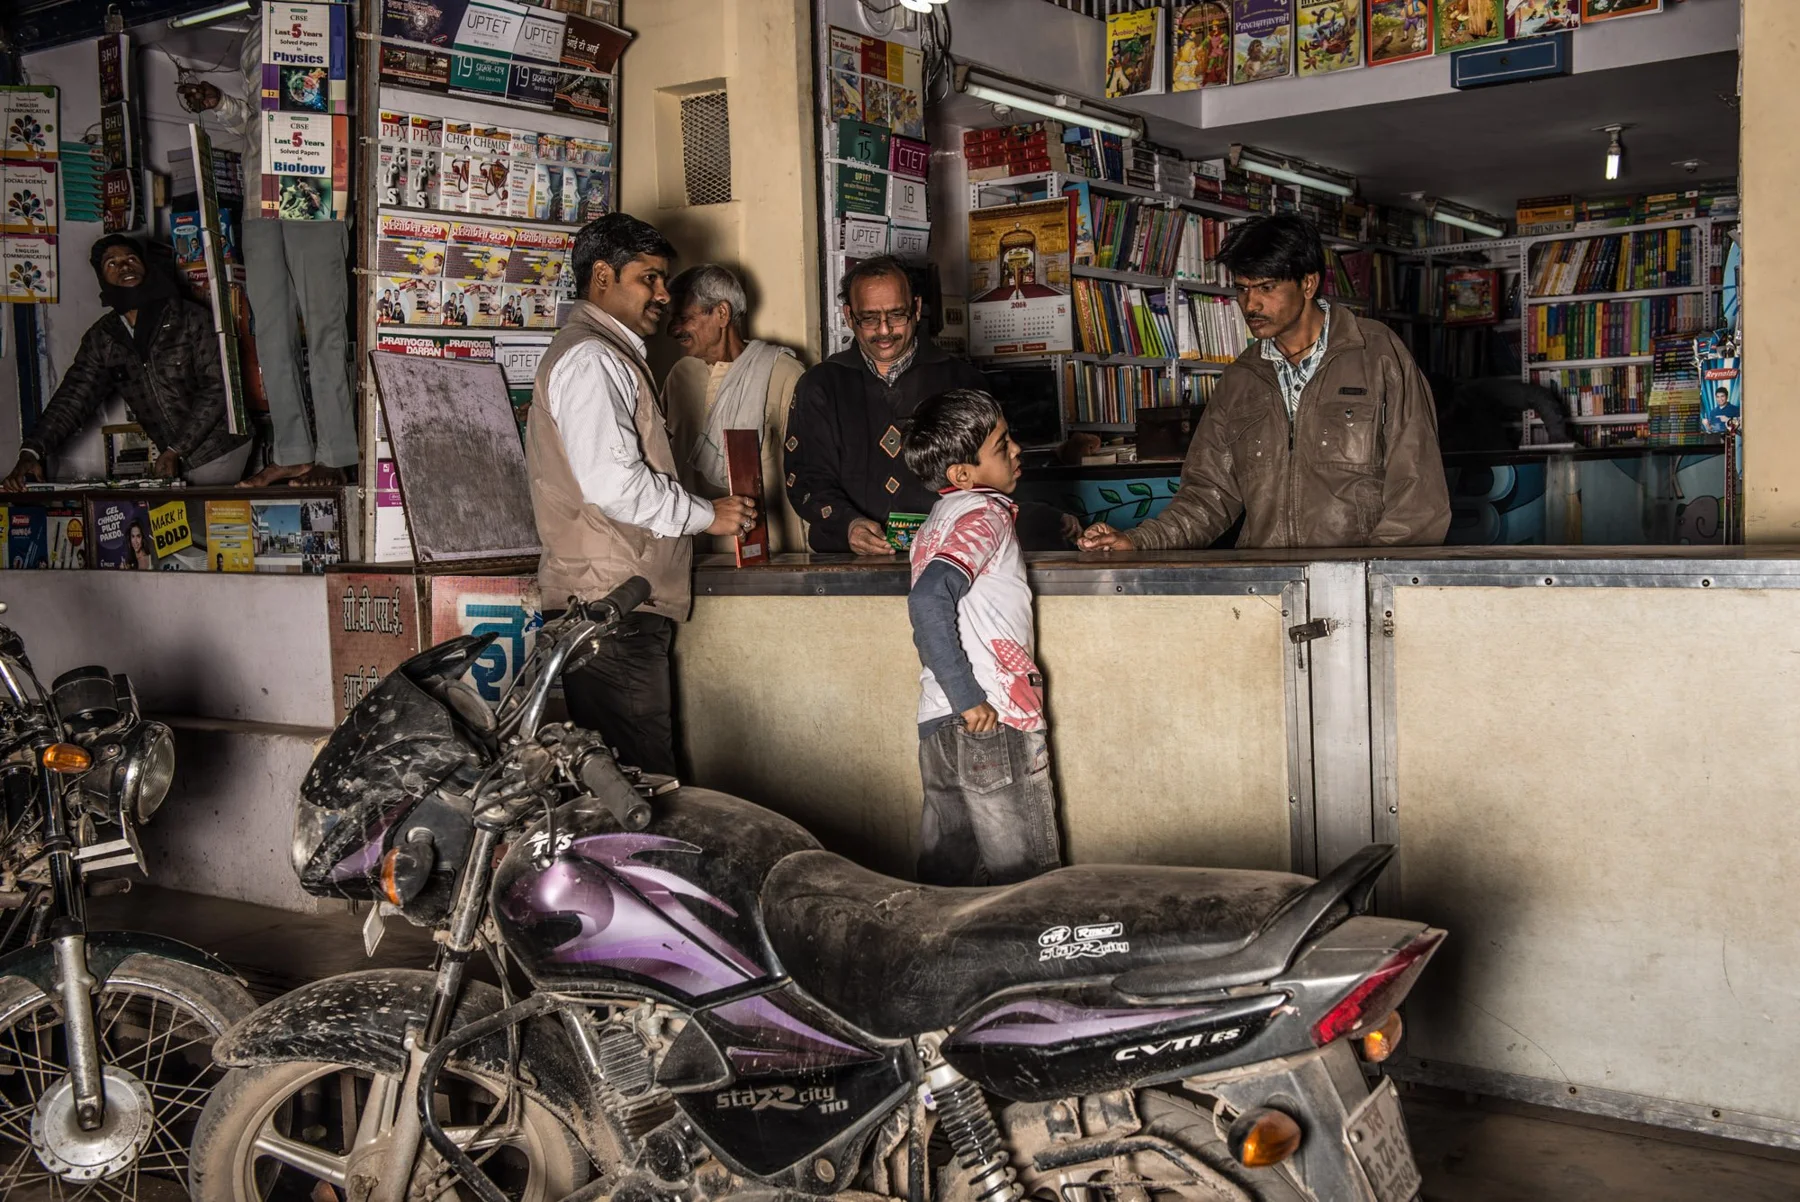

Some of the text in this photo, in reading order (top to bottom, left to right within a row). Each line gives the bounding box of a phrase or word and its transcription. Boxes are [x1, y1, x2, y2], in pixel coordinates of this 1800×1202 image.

[291, 23, 302, 38] 5
[467, 13, 511, 35] UPTET
[524, 25, 560, 46] UPTET
[273, 52, 324, 64] Physics
[457, 55, 473, 78] 19
[515, 65, 530, 88] 19
[292, 132, 302, 147] 5
[304, 139, 325, 147] Years
[858, 141, 872, 160] 15
[899, 148, 926, 170] CTET
[274, 161, 326, 175] Biology
[107, 180, 128, 194] BHU
[904, 185, 915, 204] 18
[852, 229, 880, 244] UPTET
[897, 236, 922, 249] UPTET
[382, 336, 434, 347] PRATIYOGITA
[449, 339, 492, 349] PRATIYOGITA
[406, 346, 441, 357] DARPAN
[503, 354, 540, 368] UPTET
[1706, 369, 1738, 378] Reynolds
[106, 506, 119, 515] GEL
[102, 521, 120, 533] PILOT
[152, 510, 176, 531] MARK
[155, 525, 189, 550] BOLD
[818, 1100, 849, 1114] 110
